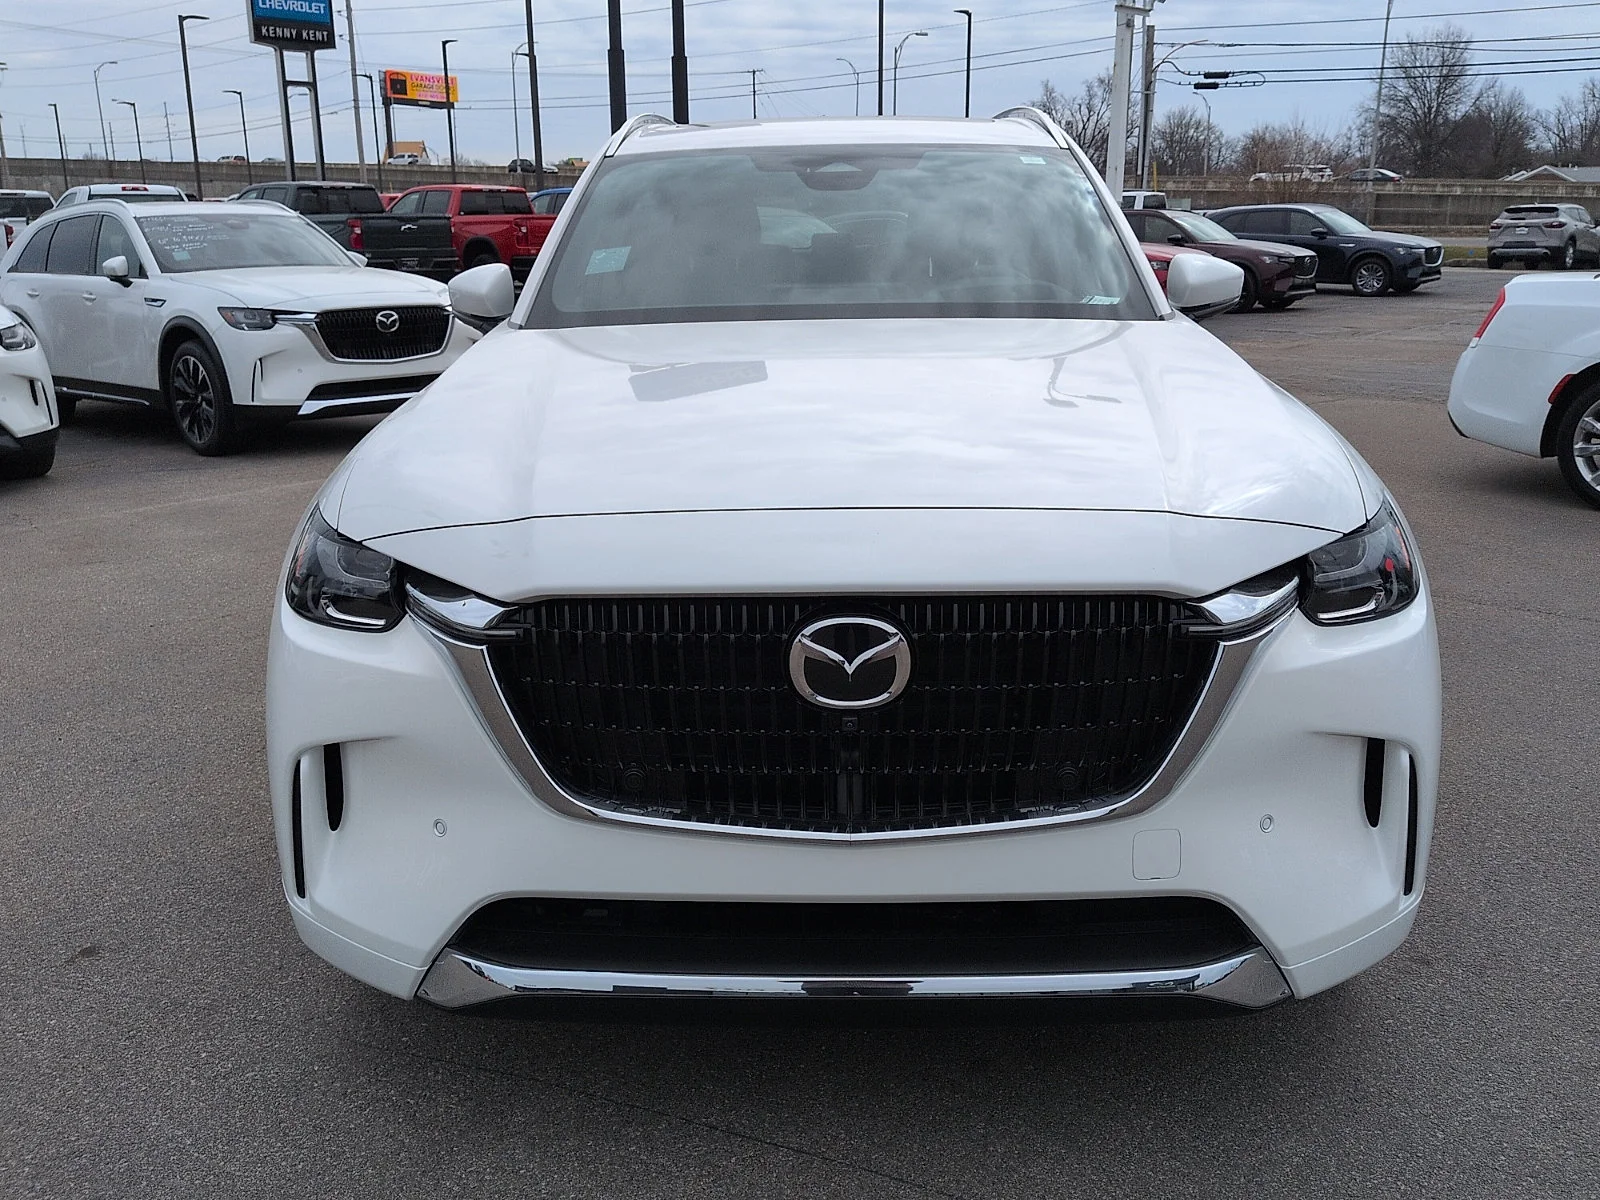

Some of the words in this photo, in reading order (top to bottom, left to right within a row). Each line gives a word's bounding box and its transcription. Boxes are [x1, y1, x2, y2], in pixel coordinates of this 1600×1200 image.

[258, 0, 326, 14] CHEVROLET
[261, 25, 297, 39] KENNY
[302, 29, 329, 42] KENT
